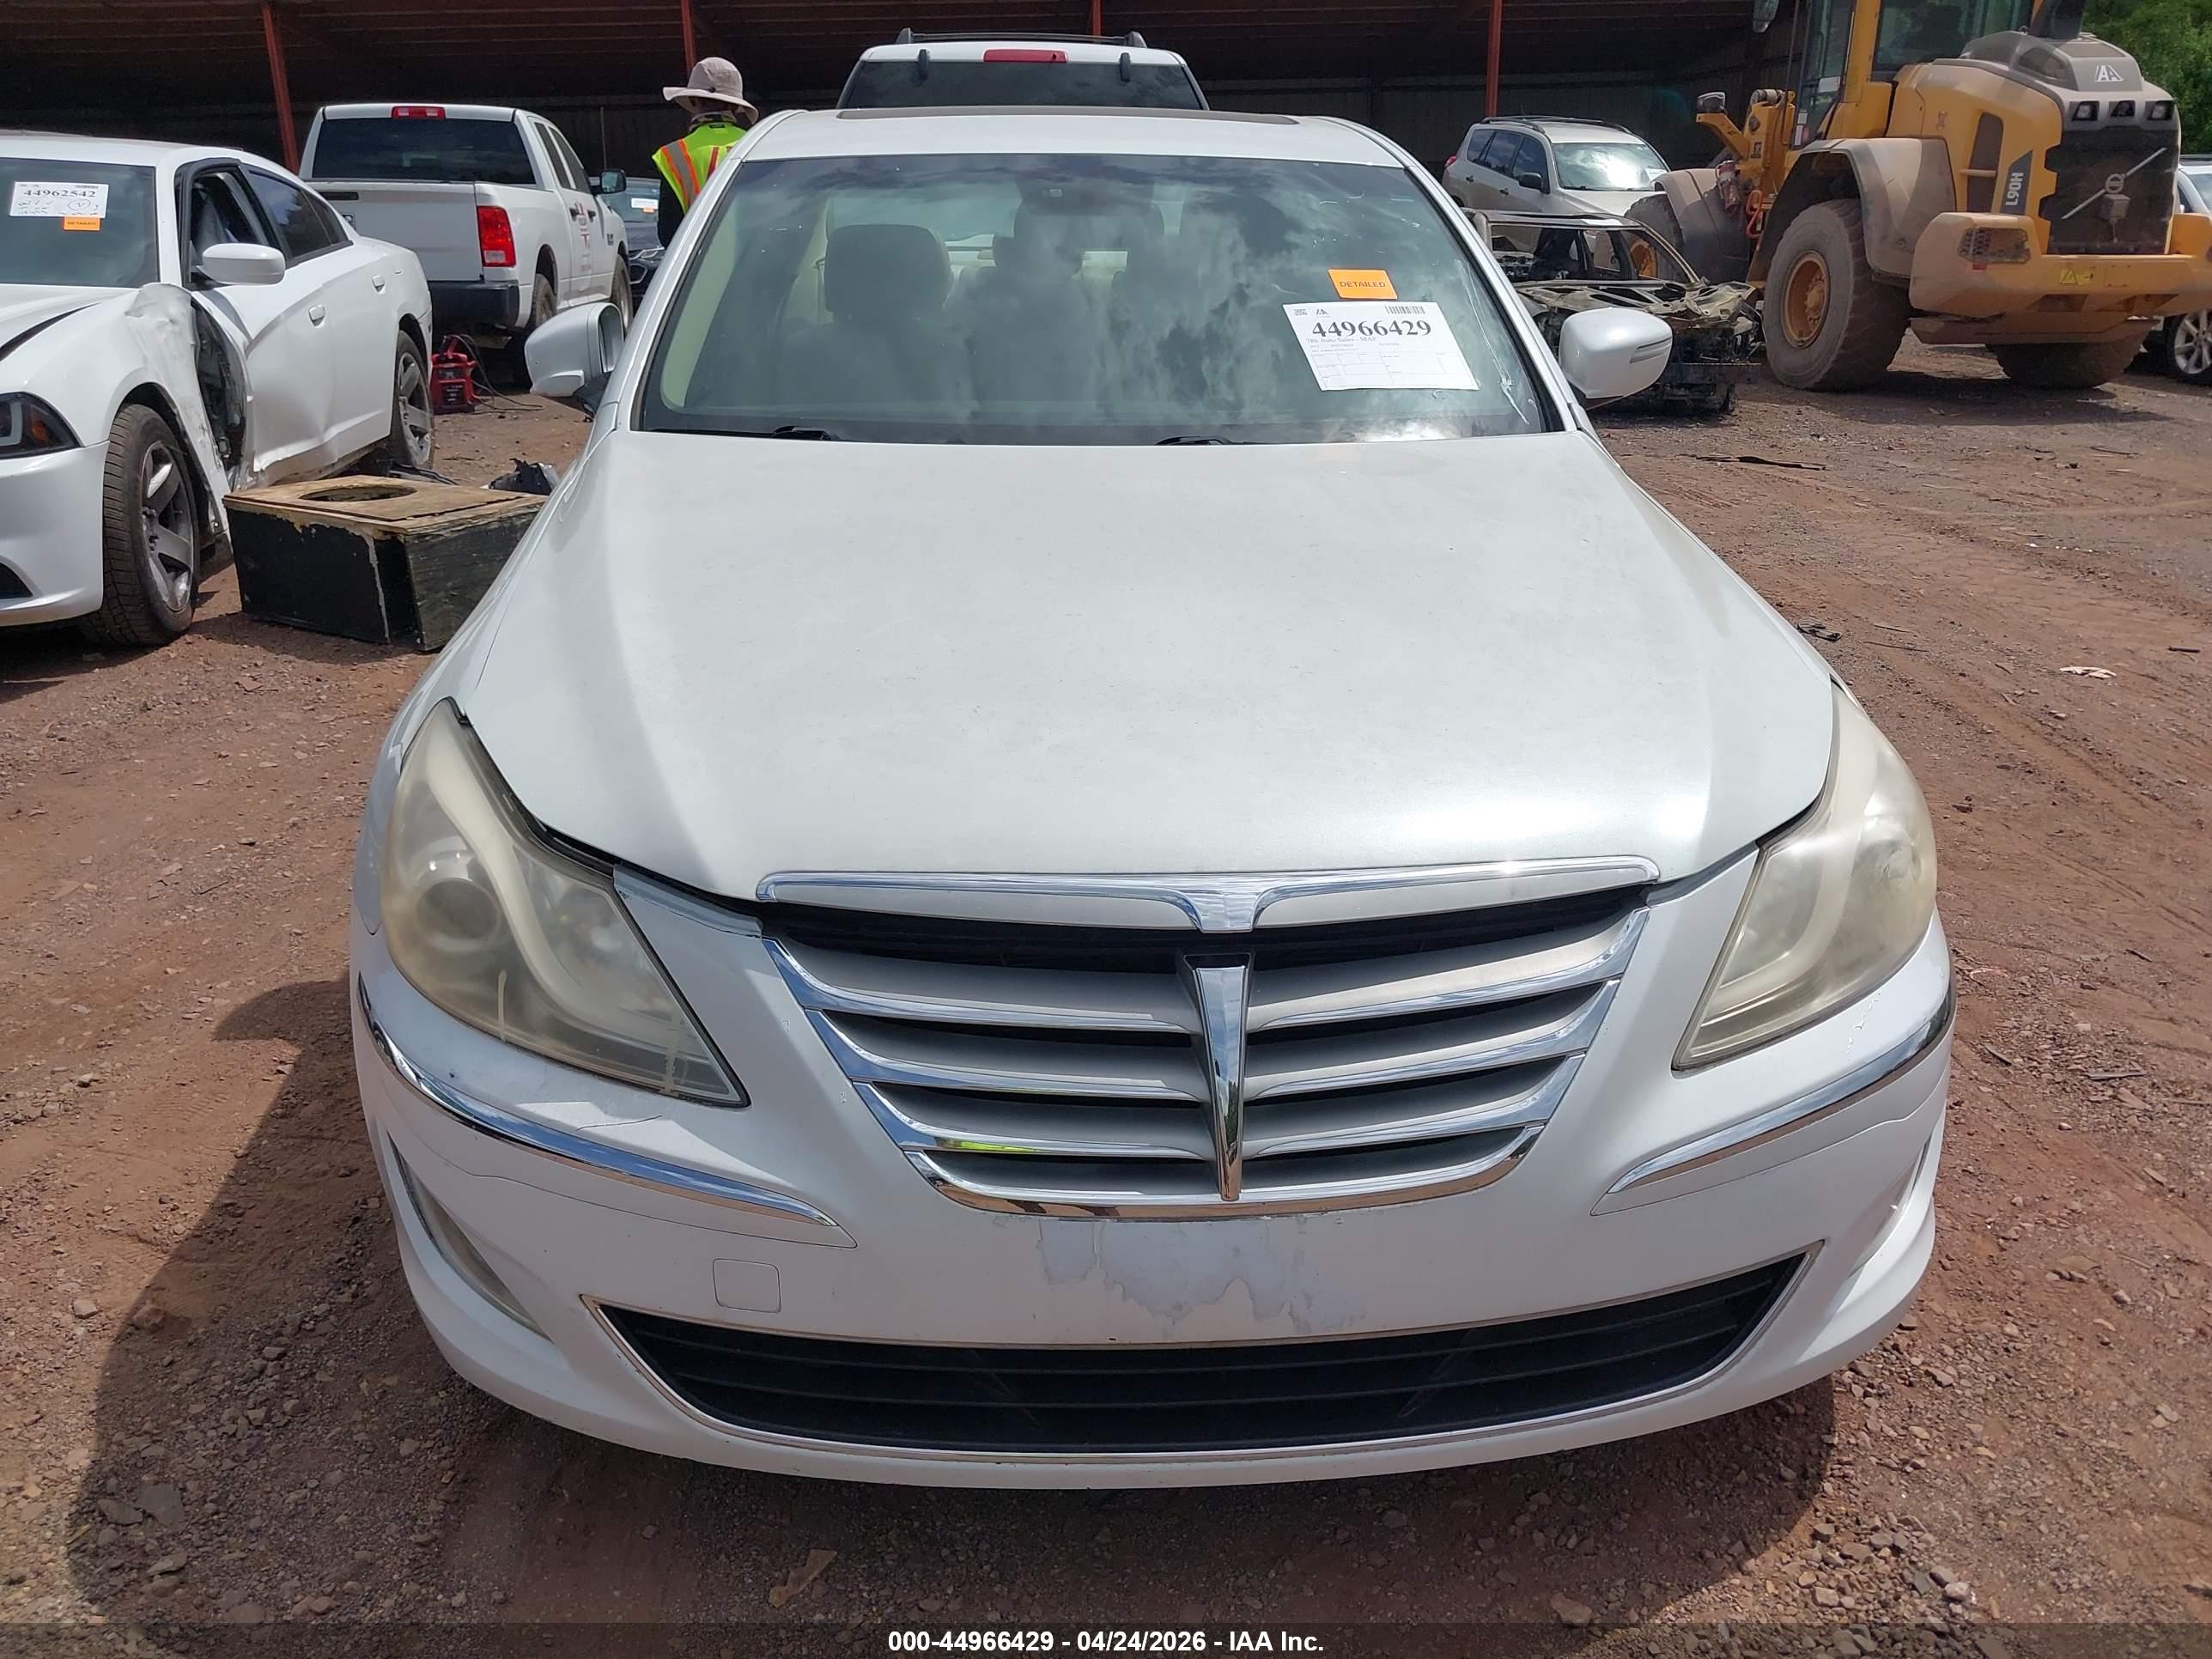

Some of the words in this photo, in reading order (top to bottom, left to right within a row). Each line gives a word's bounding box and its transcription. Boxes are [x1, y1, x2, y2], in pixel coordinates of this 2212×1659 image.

[23, 189, 96, 198] 44962542
[2005, 172, 2024, 206] L90H
[1312, 319, 1431, 337] 44966429
